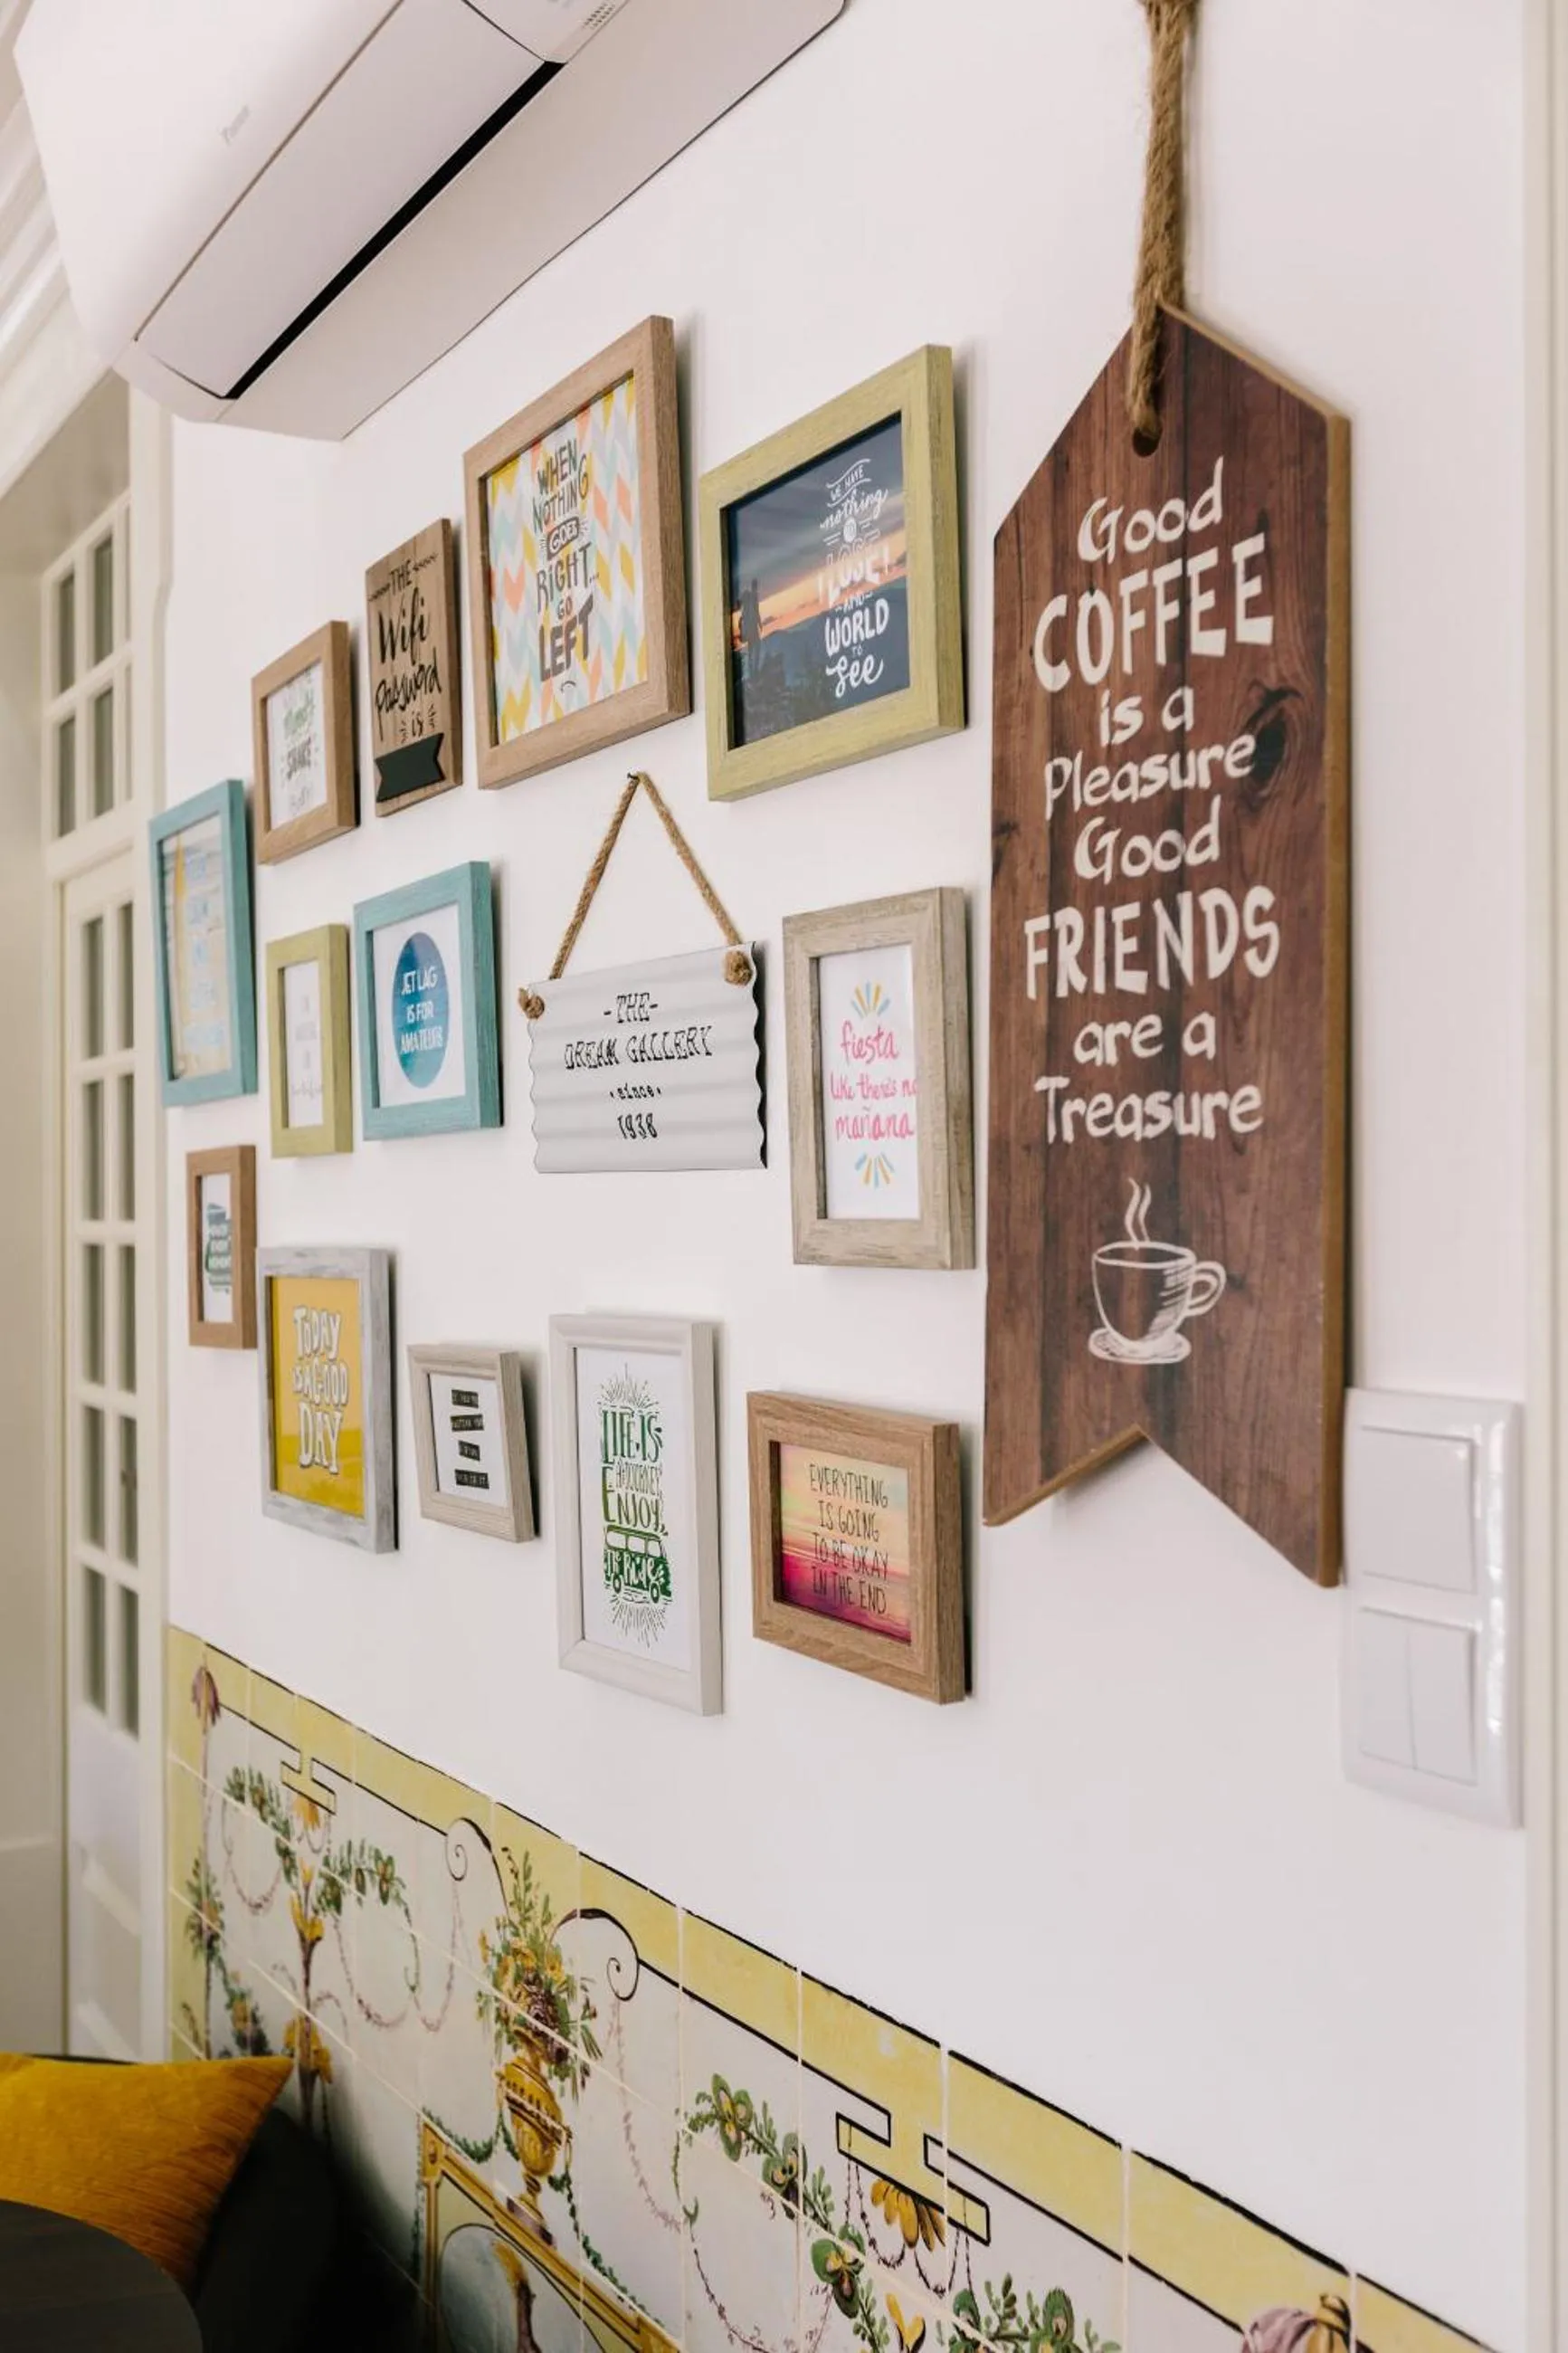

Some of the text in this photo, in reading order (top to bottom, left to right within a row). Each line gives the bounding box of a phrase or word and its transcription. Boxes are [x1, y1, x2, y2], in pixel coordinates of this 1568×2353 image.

[532, 453, 589, 533] NOTHING
[537, 439, 577, 495] WHEN
[1077, 455, 1224, 565] Good
[550, 521, 579, 553] GOES
[389, 558, 413, 596] THE
[557, 595, 573, 620] GO
[824, 598, 889, 658] WORLD
[1034, 532, 1274, 693] COFFEE
[539, 593, 594, 681] LEFT
[412, 710, 424, 737] is
[1099, 686, 1194, 748] is a
[1074, 794, 1221, 885] Good
[1024, 885, 1280, 1001] FRIENDS
[401, 966, 439, 996] JET LAG
[406, 1001, 434, 1024] IS FOR
[564, 1025, 713, 1070] DREAM GALLERY
[840, 1020, 900, 1067] fiesta
[1073, 1012, 1216, 1067] are a
[617, 1112, 659, 1139] 1938
[835, 1105, 916, 1141] mañana
[1033, 1075, 1264, 1145] Treasure
[299, 1399, 343, 1474] DAY
[602, 1409, 660, 1465] LIFE IS
[602, 1465, 660, 1533] ENJOY
[809, 1463, 889, 1509] EVERYTHING
[818, 1500, 880, 1542] IS GOING
[812, 1532, 889, 1582] TO BE OKAY
[811, 1566, 887, 1615] IN THE END
